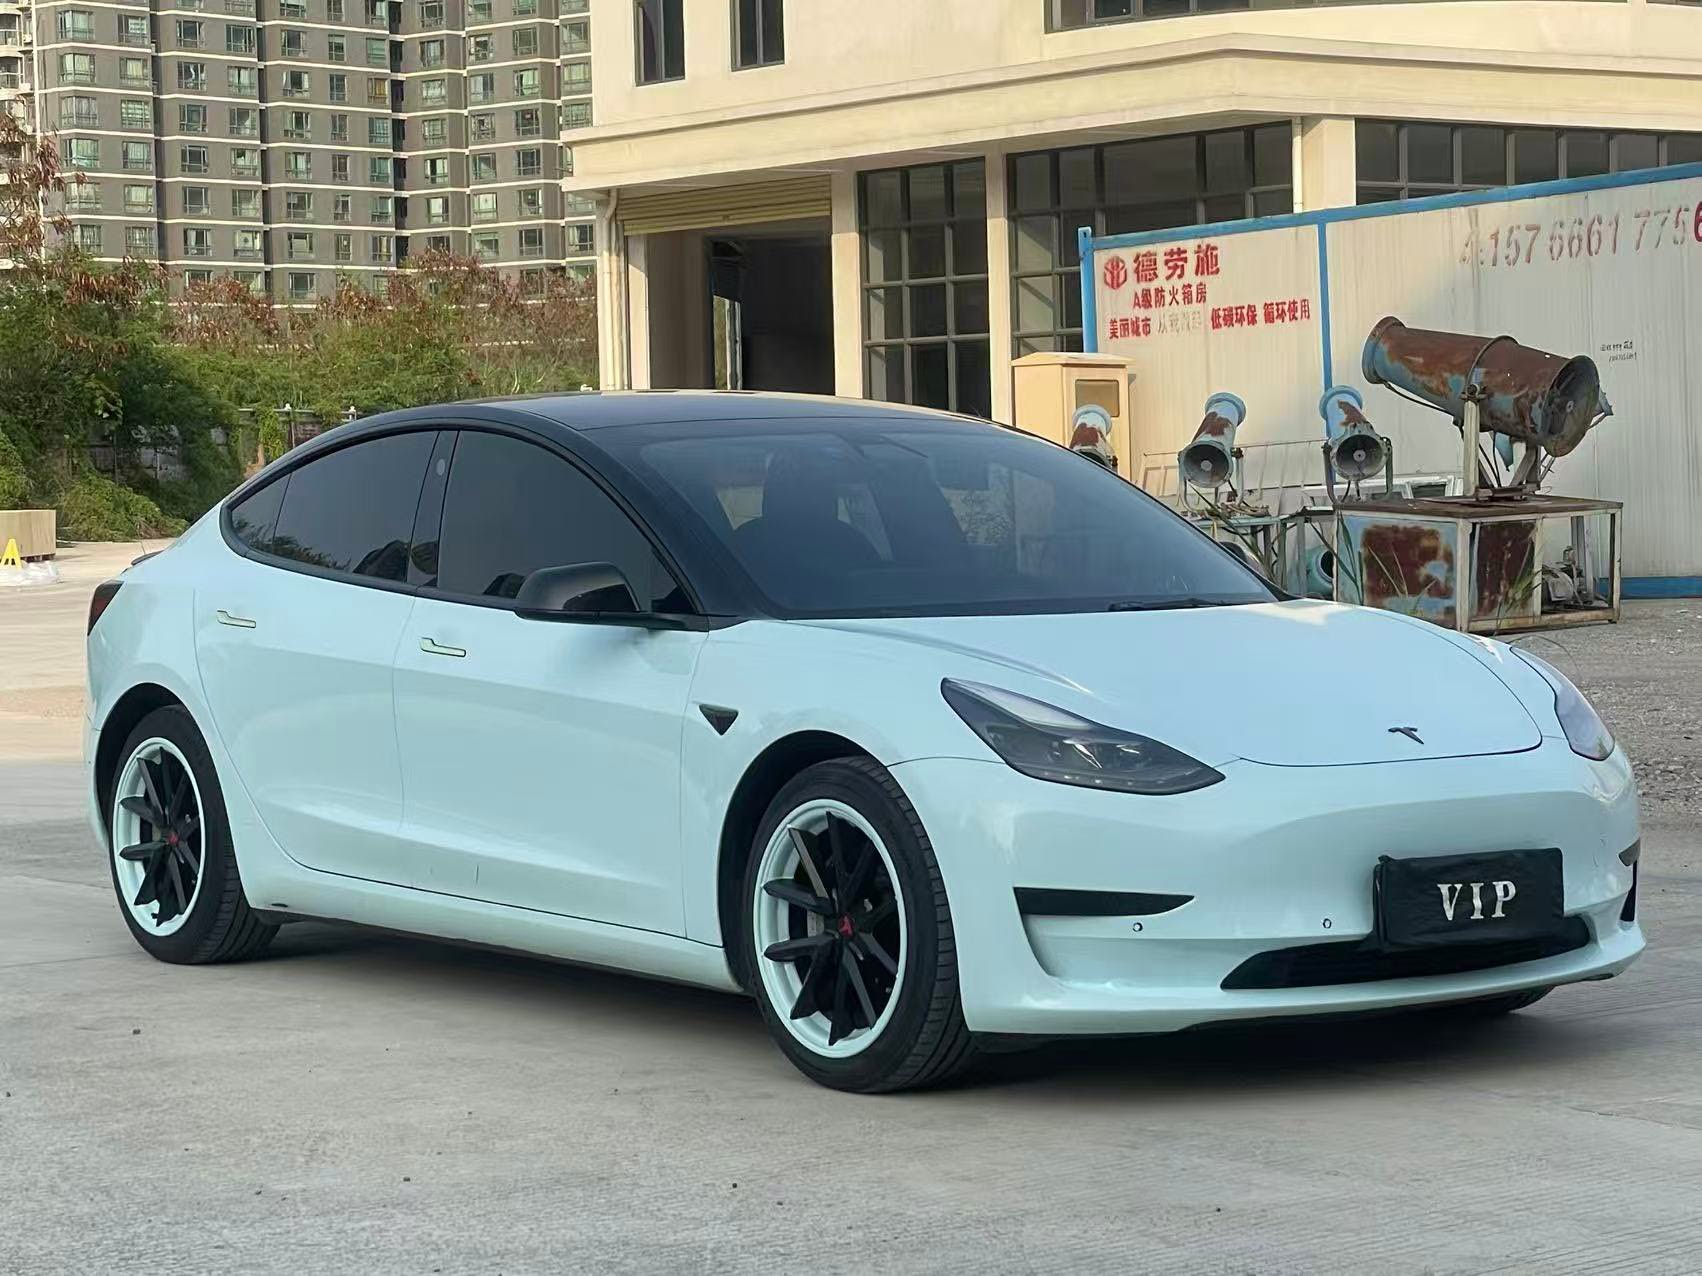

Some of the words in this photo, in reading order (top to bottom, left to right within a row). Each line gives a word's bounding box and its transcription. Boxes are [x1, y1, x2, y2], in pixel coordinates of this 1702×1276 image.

[1133, 242, 1221, 284] 德劳施
[1132, 281, 1207, 310] A级防火箱房
[1109, 316, 1152, 340] 美丽城市
[1211, 303, 1258, 330] 低碳环保
[1263, 298, 1311, 324] 循环使用
[1437, 881, 1517, 921] VIP
